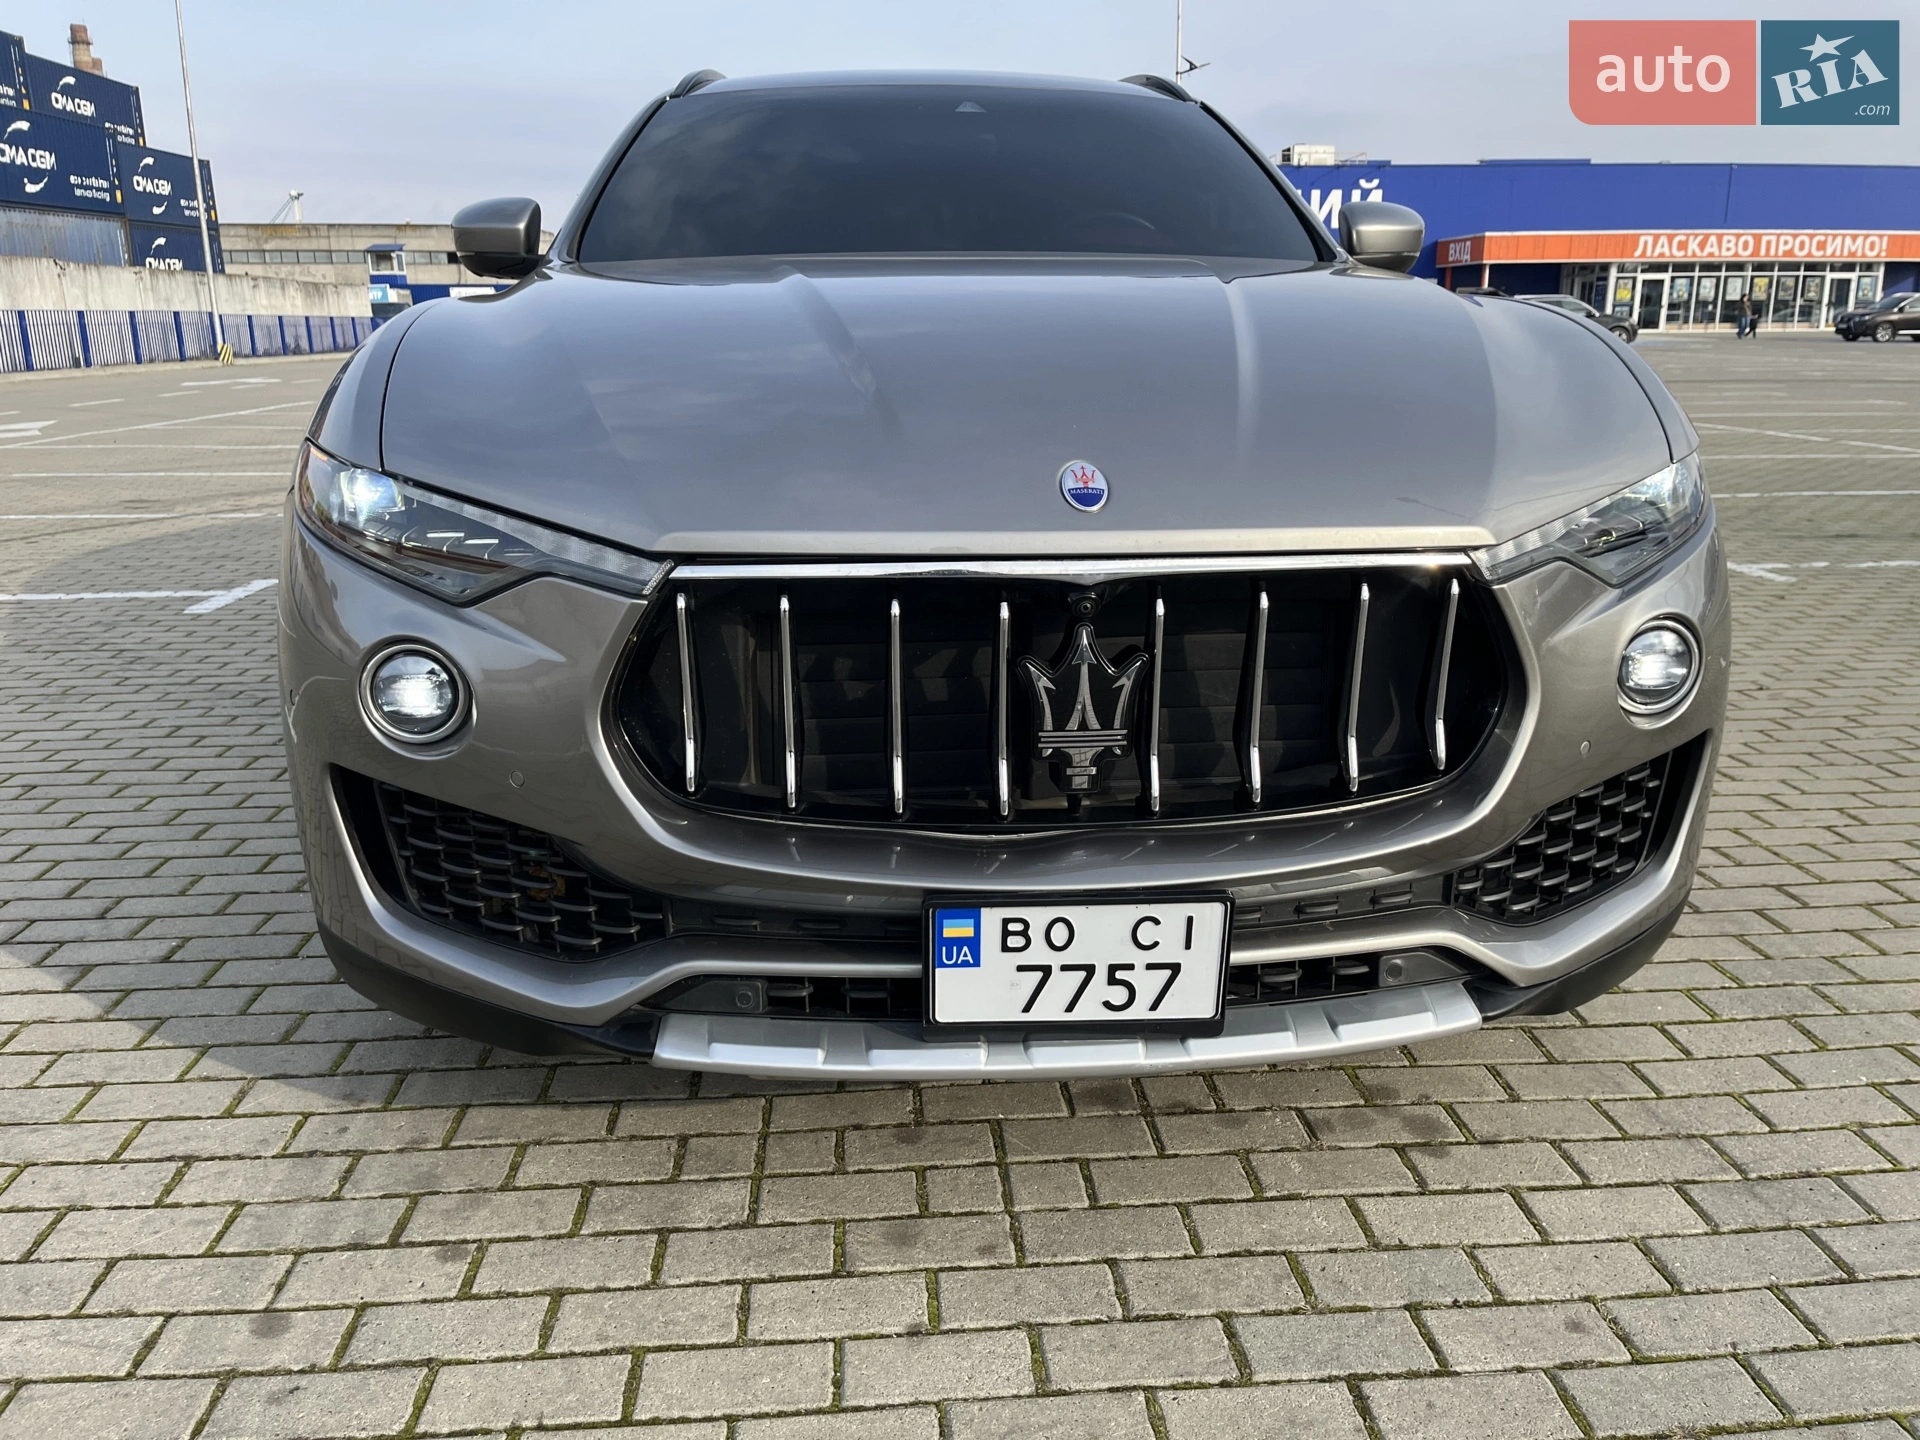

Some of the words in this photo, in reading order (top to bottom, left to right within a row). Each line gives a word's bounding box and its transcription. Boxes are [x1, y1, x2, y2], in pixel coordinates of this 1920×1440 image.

[28, 147, 57, 170] CGM
[1448, 240, 1472, 263] ВХІД
[1634, 233, 1755, 258] ЛАСКАВО
[1759, 233, 1889, 258] ПРОСИМО!
[1001, 916, 1075, 953] BO
[1131, 915, 1195, 951] CI
[942, 945, 973, 965] UA
[1016, 962, 1182, 1013] 7757
